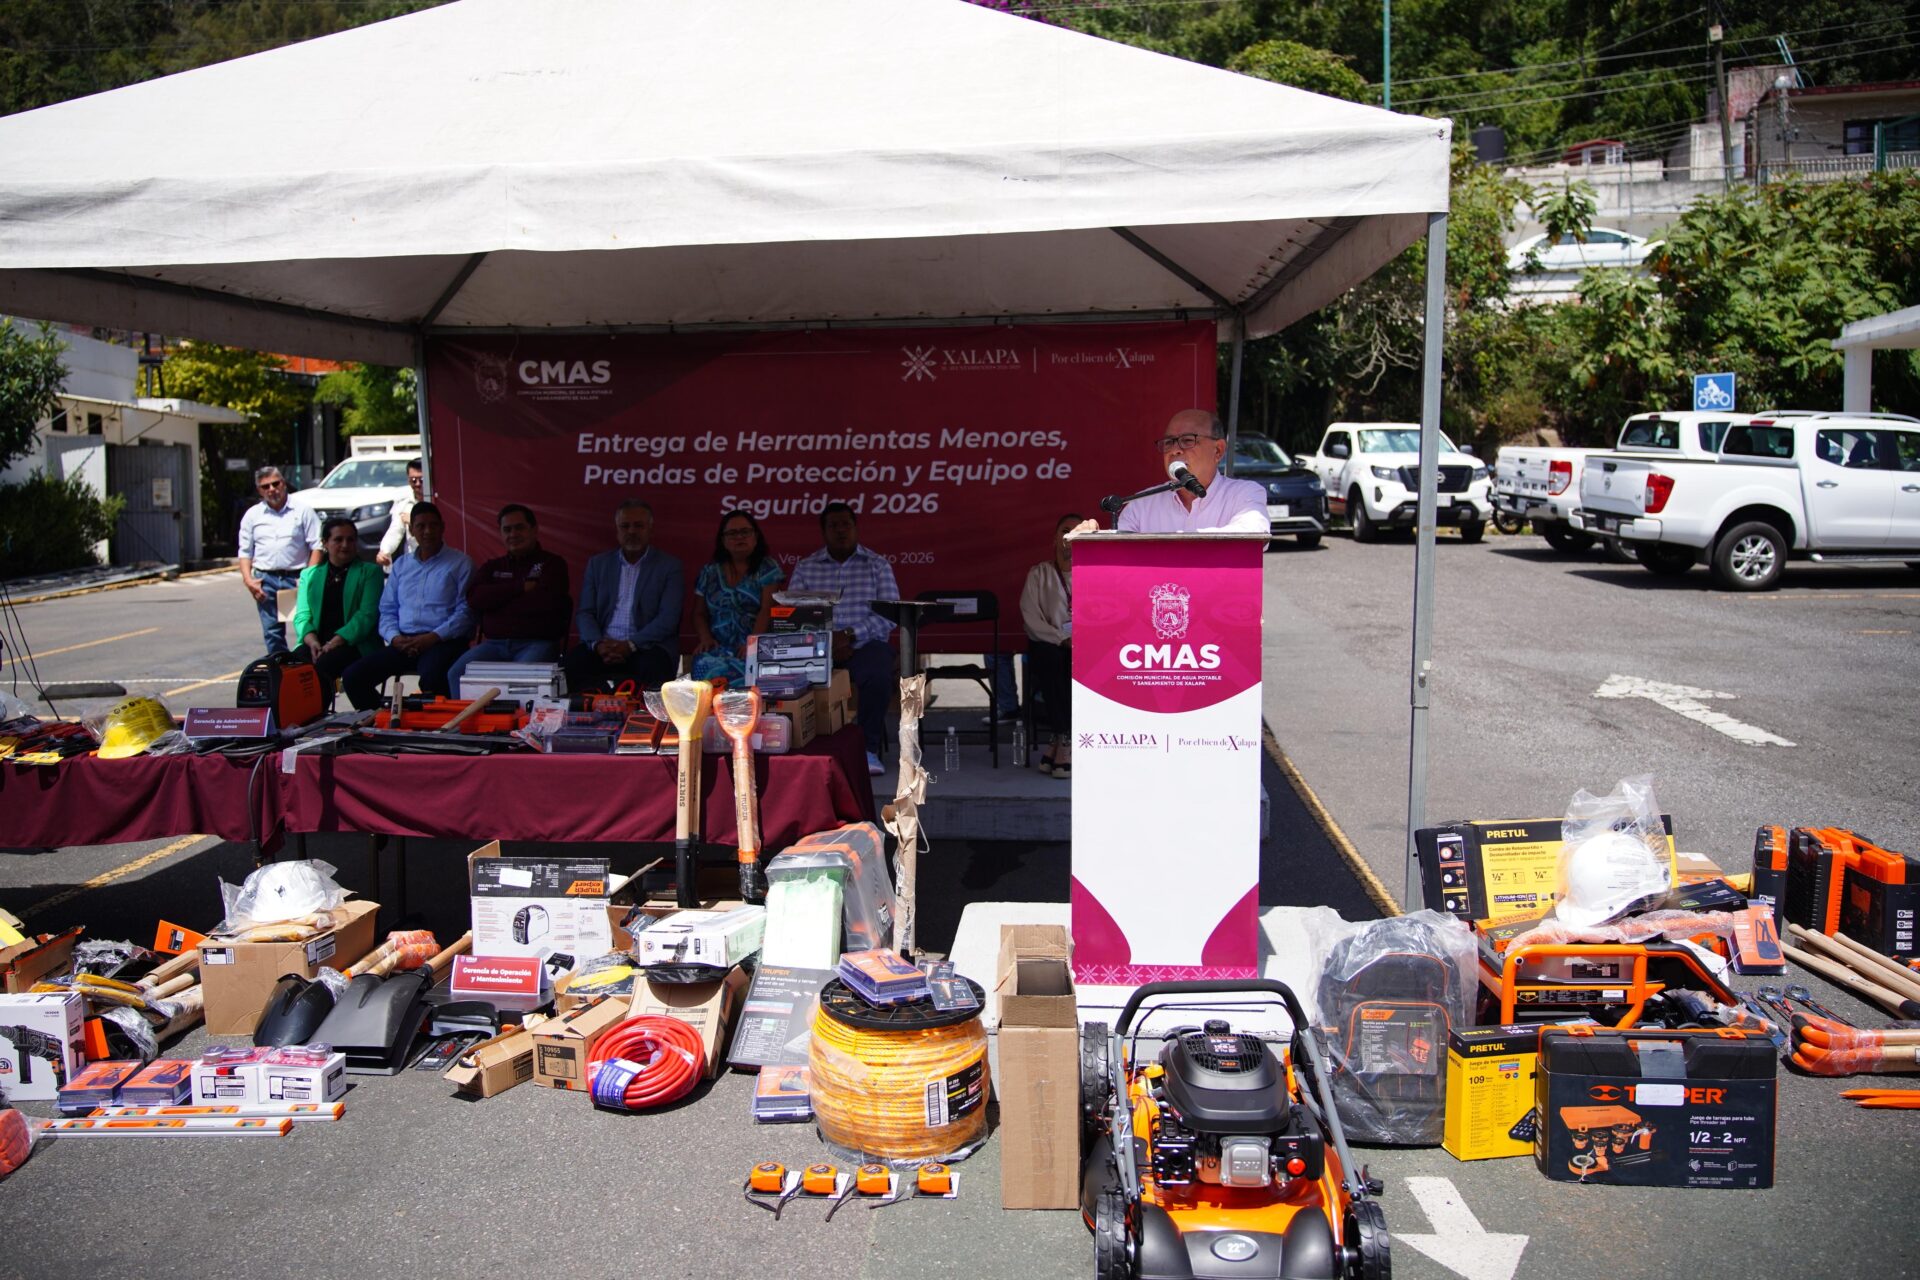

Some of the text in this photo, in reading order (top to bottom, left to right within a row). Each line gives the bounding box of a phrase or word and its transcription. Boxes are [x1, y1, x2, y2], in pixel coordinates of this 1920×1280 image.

[942, 349, 1020, 365] XALAPA
[1051, 347, 1155, 369] Por el bien de Xalapa
[518, 360, 611, 385] CMAS
[577, 428, 1068, 457] Entrega de Herramientas Menores,
[584, 458, 1072, 487] Prendas de Protección y Equipo de
[871, 493, 939, 514] 2026
[900, 552, 935, 564] 2026
[1119, 643, 1221, 669] CMAS
[1098, 733, 1157, 745] XALAPA
[1178, 735, 1257, 751] Por el bien de Xalapa
[1486, 829, 1528, 839] PRETUL
[500, 969, 531, 977] Operación
[761, 968, 791, 976] TRUPER
[476, 976, 523, 984] Mantenimiento
[1470, 1043, 1505, 1053] PRETUL
[1469, 1075, 1485, 1084] 109
[1624, 1085, 1724, 1105] TER
[1689, 1131, 1711, 1143] 1/2
[1722, 1132, 1732, 1143] 2
